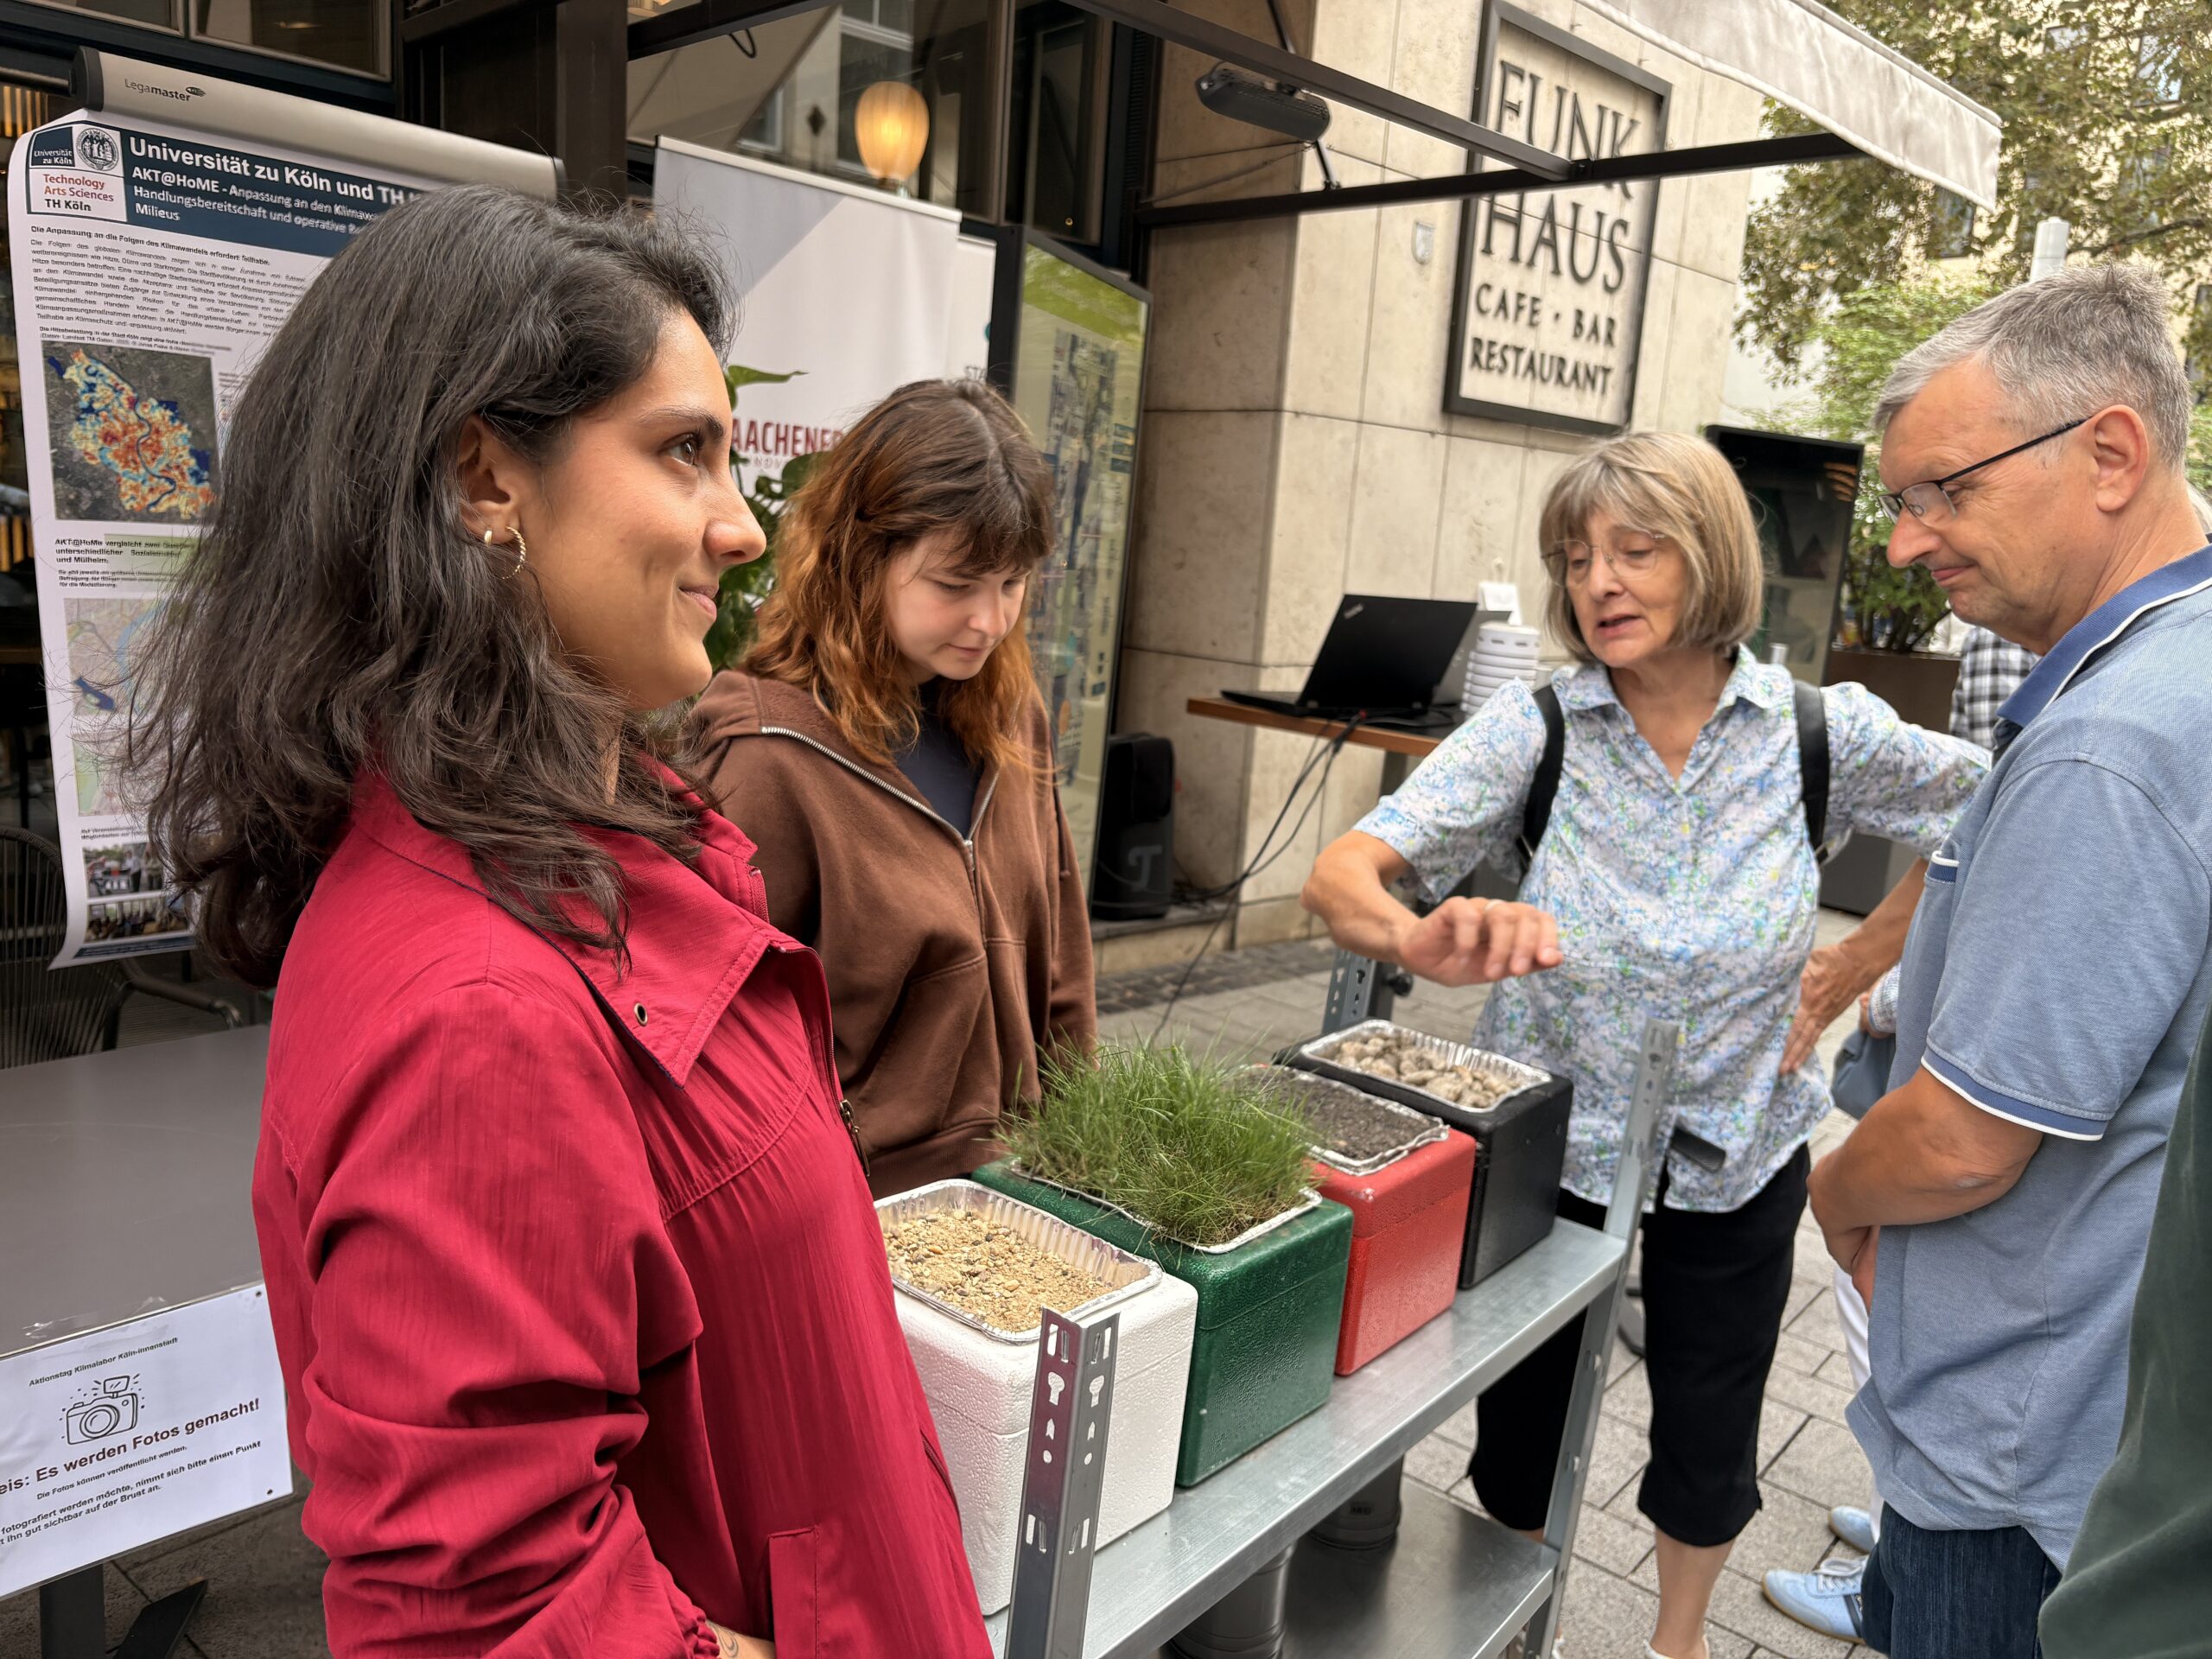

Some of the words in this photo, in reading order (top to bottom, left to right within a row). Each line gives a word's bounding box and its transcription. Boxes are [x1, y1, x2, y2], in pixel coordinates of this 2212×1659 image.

[124, 78, 191, 102] Legamaster
[1497, 60, 1641, 200] FUNK
[34, 149, 73, 158] Universität
[53, 156, 73, 165] Köln
[129, 136, 251, 177] Universität
[254, 164, 280, 182] zu
[284, 166, 332, 193] Köln
[336, 181, 375, 201] und
[376, 186, 405, 205] TH
[43, 174, 105, 191] Technology
[44, 186, 67, 196] Arts
[68, 187, 114, 202] Sciences
[45, 198, 61, 209] TH
[64, 200, 92, 212] Köln
[131, 166, 219, 194] AKT@HoME
[229, 184, 293, 208] Anpassung
[294, 197, 308, 209] an
[310, 199, 333, 214] den
[133, 185, 268, 219] Handlungsbereitschaft
[269, 211, 292, 223] und
[294, 216, 346, 233] operative
[135, 202, 181, 221] Milieus
[46, 226, 92, 238] Anpassung
[118, 235, 144, 245] Folgen
[145, 239, 159, 248] des
[161, 241, 207, 256] Klimawandels
[1479, 191, 1630, 294] HAUS
[1475, 283, 1541, 327] CAFE
[1572, 308, 1616, 347] BAR
[1470, 336, 1614, 396] RESTAURANT
[29, 1369, 73, 1388] Aktionstag
[73, 1356, 117, 1374] Klimalabor
[35, 1466, 59, 1483] Es
[63, 1443, 128, 1473] werden
[132, 1426, 180, 1450] Fotos
[184, 1397, 260, 1435] gemacht!
[0, 1510, 57, 1535] fotografiert
[59, 1497, 94, 1515] werden
[95, 1484, 134, 1502] möchte,
[135, 1472, 165, 1488] nimmt
[166, 1465, 185, 1478] sich
[187, 1459, 207, 1471] bitte
[208, 1450, 234, 1463] einen
[235, 1440, 262, 1455] Punkt
[52, 1483, 75, 1495] Fotos
[76, 1472, 105, 1486] können
[106, 1453, 157, 1475] veröffentlicht
[24, 1525, 41, 1538] gut
[43, 1511, 83, 1529] sichtbar
[85, 1503, 101, 1516] auf
[102, 1498, 118, 1510] der
[120, 1489, 146, 1503] Brust
